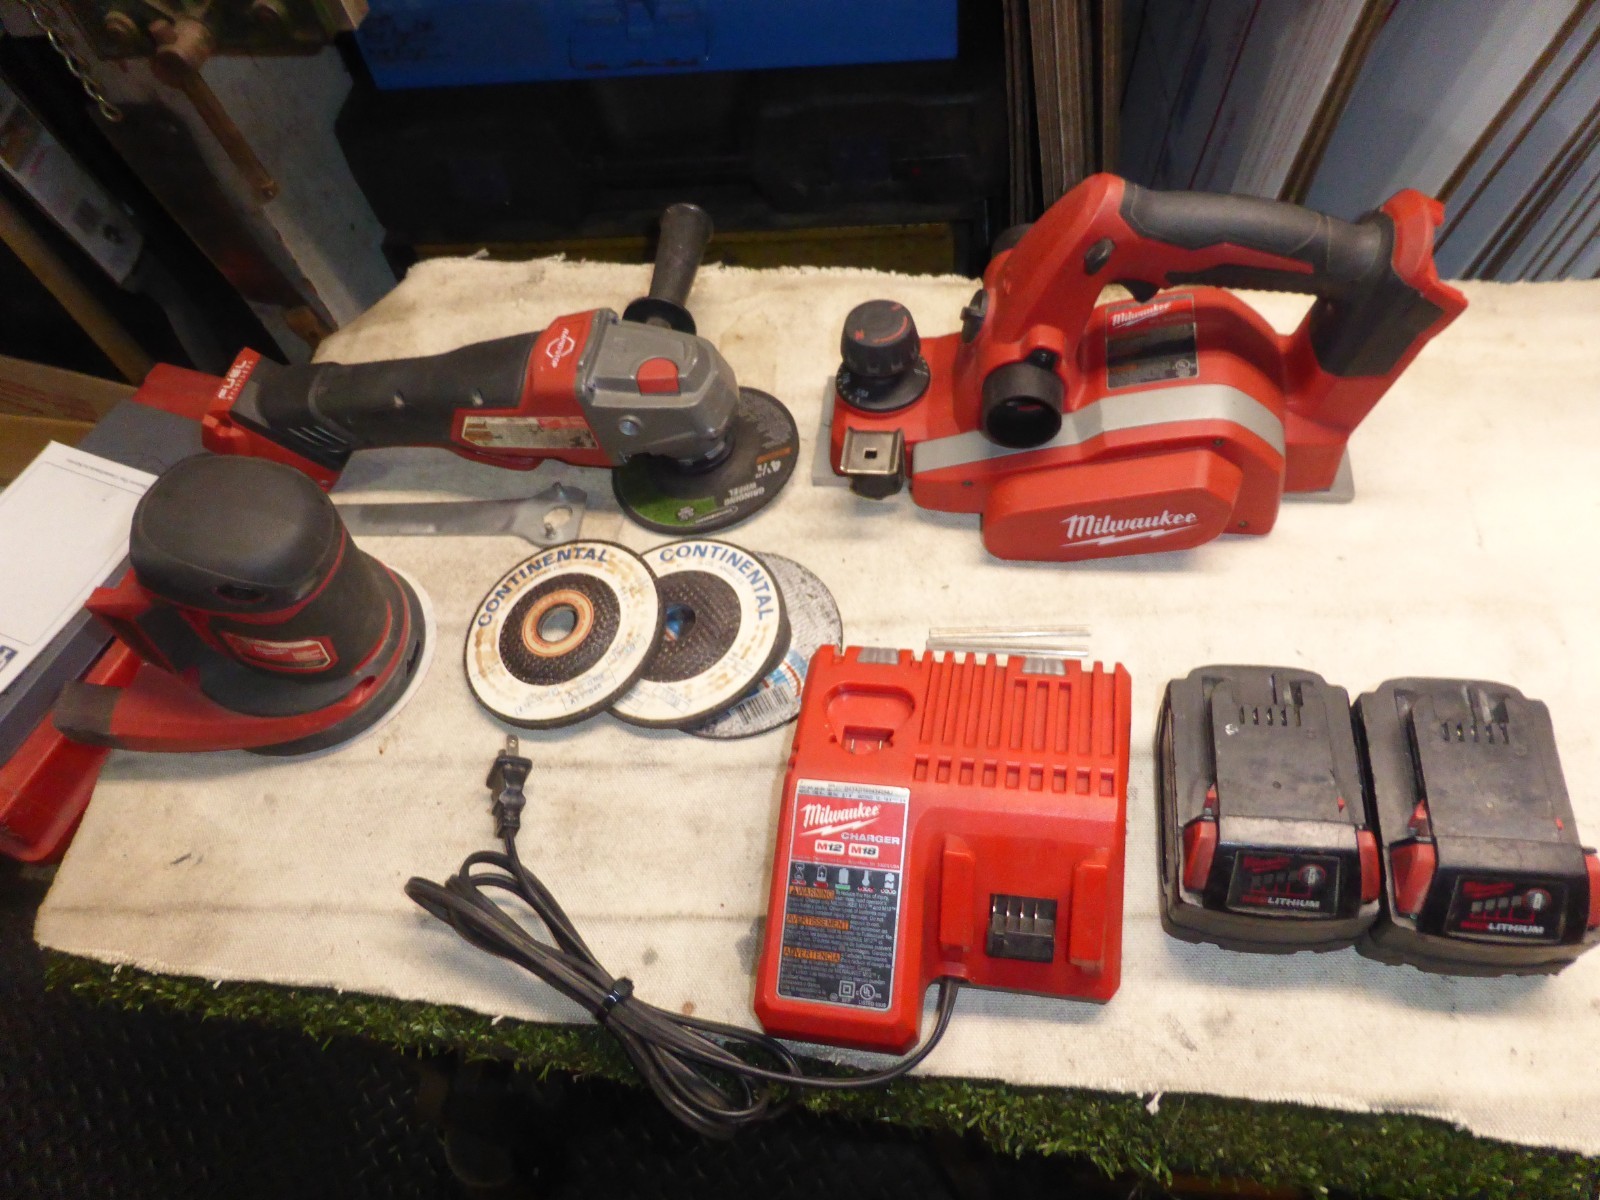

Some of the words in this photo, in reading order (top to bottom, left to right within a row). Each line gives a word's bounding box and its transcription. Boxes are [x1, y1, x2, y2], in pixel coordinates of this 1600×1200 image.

[218, 360, 247, 399] FUEL
[1060, 510, 1197, 540] Milwaukee
[478, 546, 608, 627] CONTINENTAL
[659, 544, 774, 621] CONTINENTAL
[800, 801, 880, 829] Milwaukee
[816, 842, 843, 852] M12
[850, 845, 877, 856] M18
[841, 832, 900, 845] CHARGER
